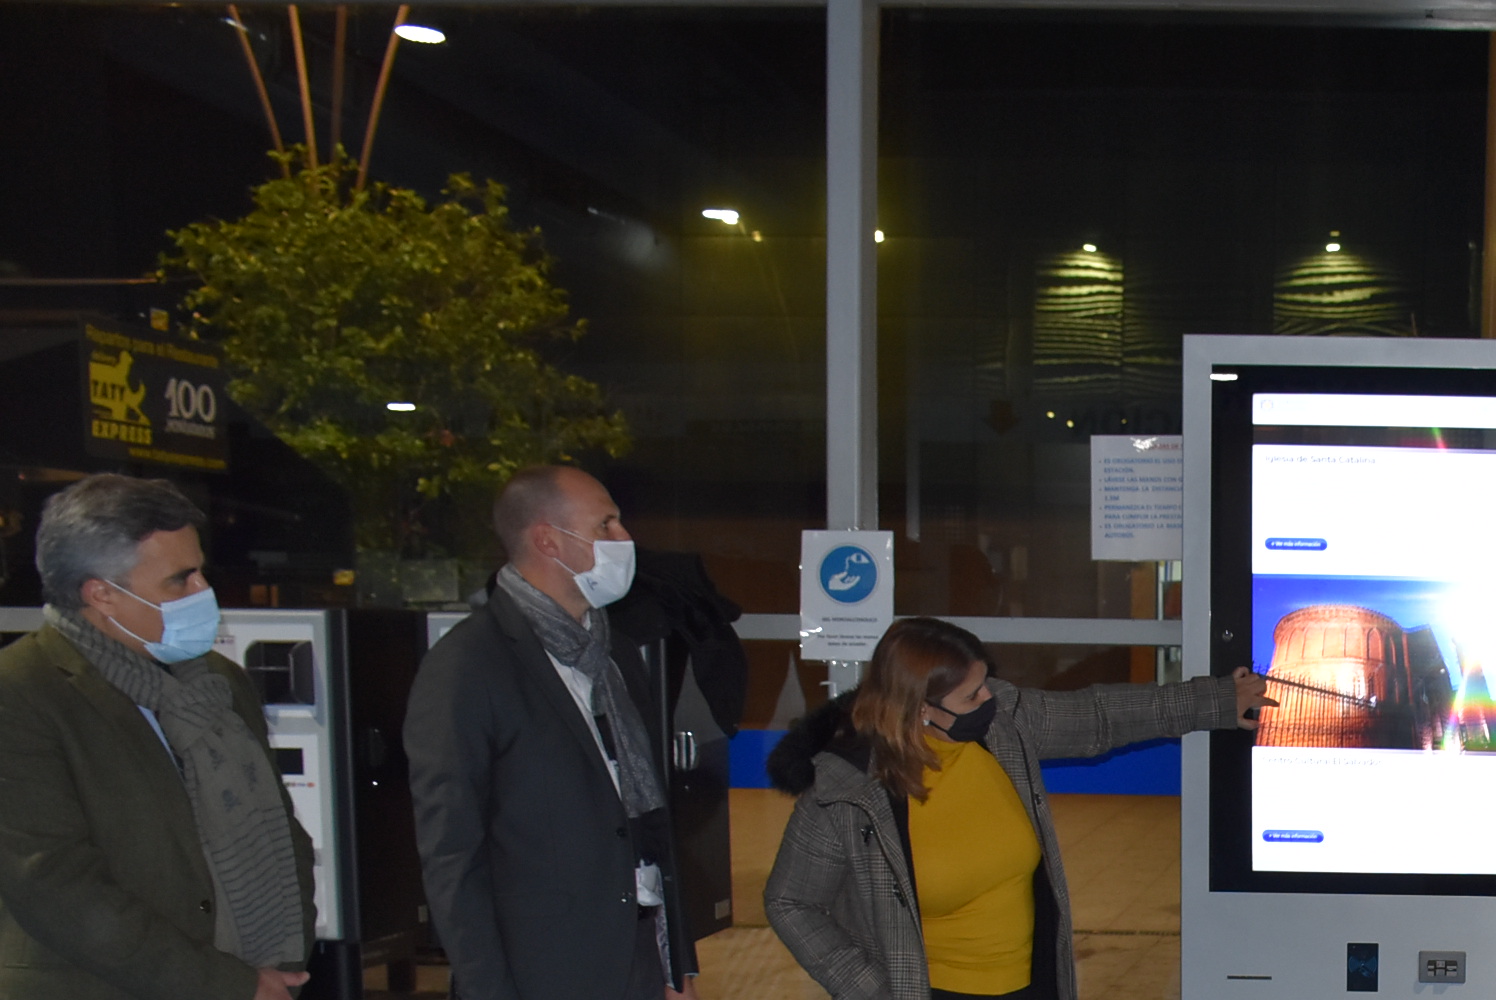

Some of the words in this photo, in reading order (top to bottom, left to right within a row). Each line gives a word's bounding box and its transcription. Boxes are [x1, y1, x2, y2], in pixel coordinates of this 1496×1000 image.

[92, 379, 126, 401] TATY
[165, 376, 217, 424] 100
[1310, 455, 1337, 464] Santa
[1339, 456, 1376, 465] Catalina
